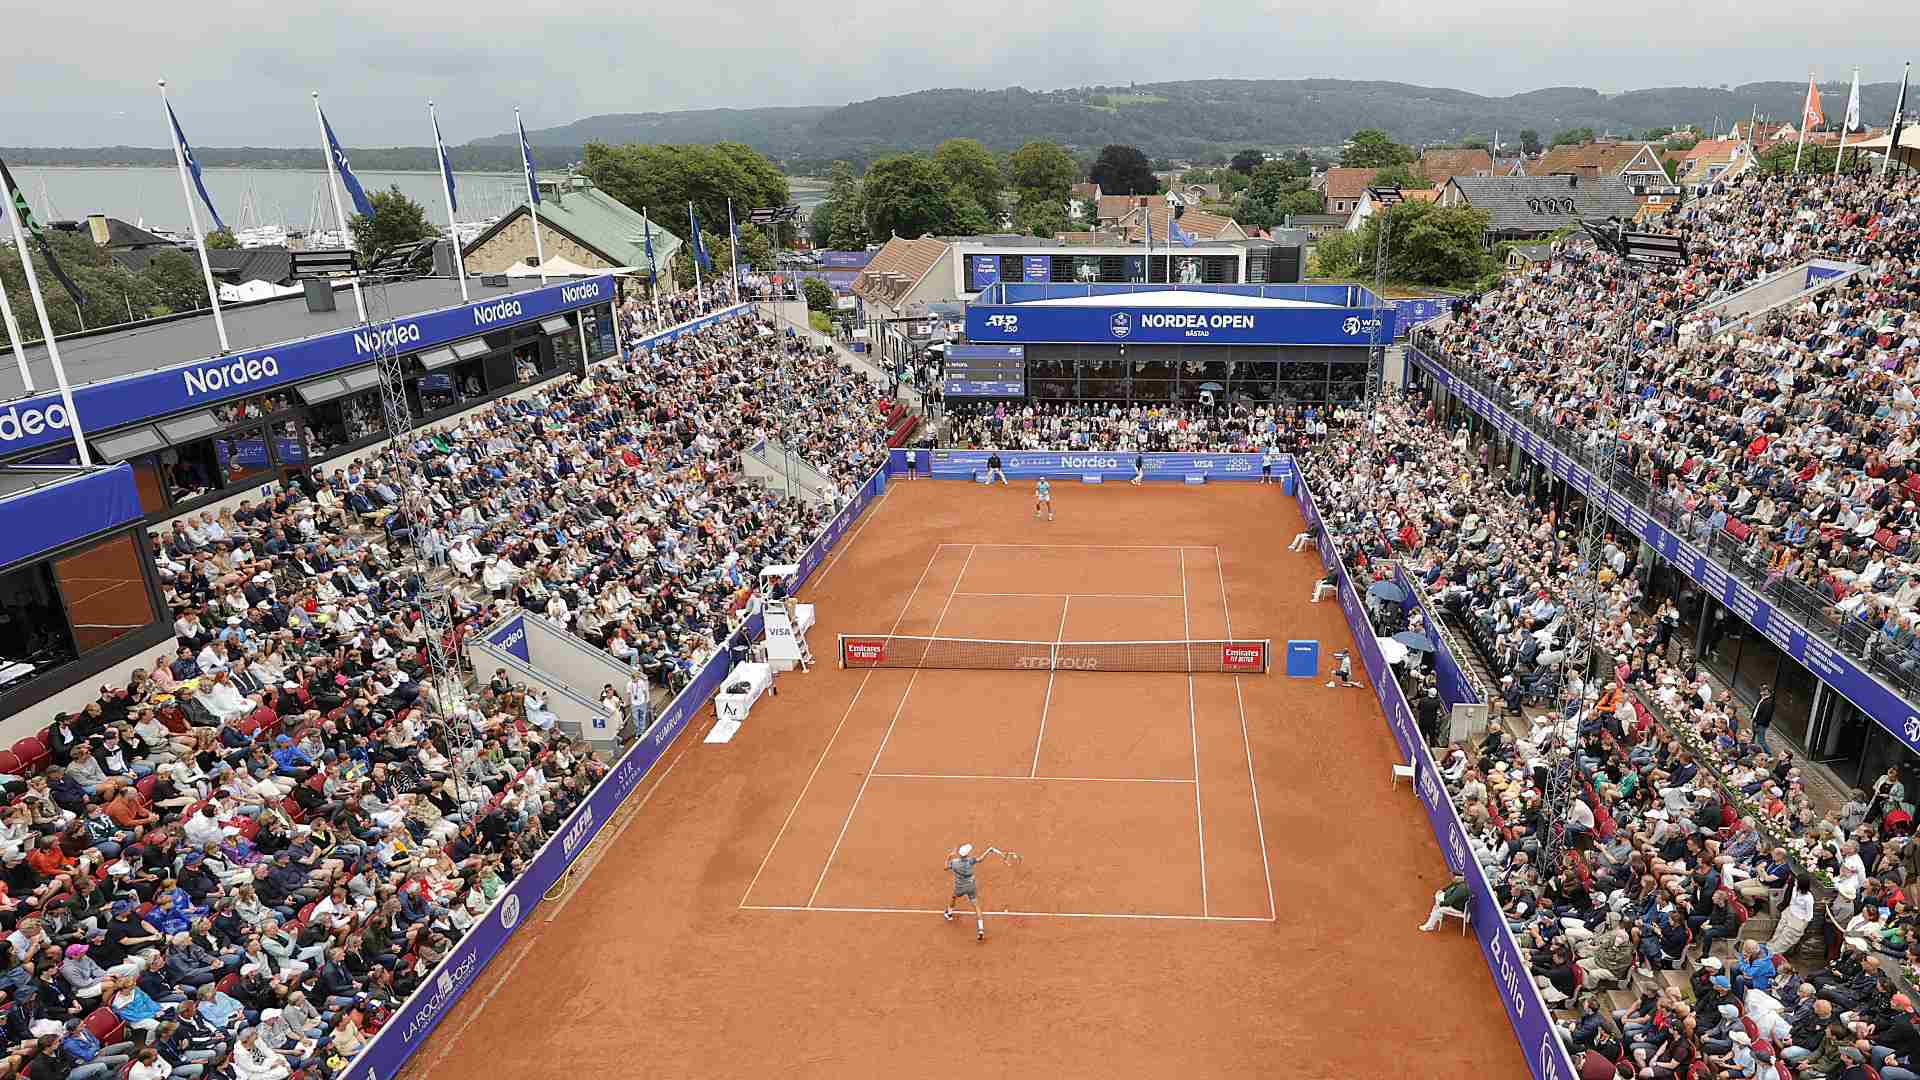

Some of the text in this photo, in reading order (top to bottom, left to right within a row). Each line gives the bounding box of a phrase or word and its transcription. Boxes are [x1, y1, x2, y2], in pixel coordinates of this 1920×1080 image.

[562, 282, 599, 303] Nordea
[473, 300, 522, 325] Nordea
[984, 314, 1018, 327] ATP
[1141, 314, 1254, 329] NORDEA OPEN
[354, 323, 420, 355] Nordea
[1185, 329, 1210, 337] BÅSTAD
[183, 356, 279, 396] Nordea
[1061, 456, 1118, 468] Nordea
[1193, 460, 1214, 468] VISA
[769, 628, 791, 636] VISA
[848, 644, 881, 652] Emirates
[1225, 648, 1259, 656] Emirates
[1055, 656, 1098, 669] TOUR
[1501, 951, 1525, 1018] bilia
[402, 1022, 418, 1042] LA
